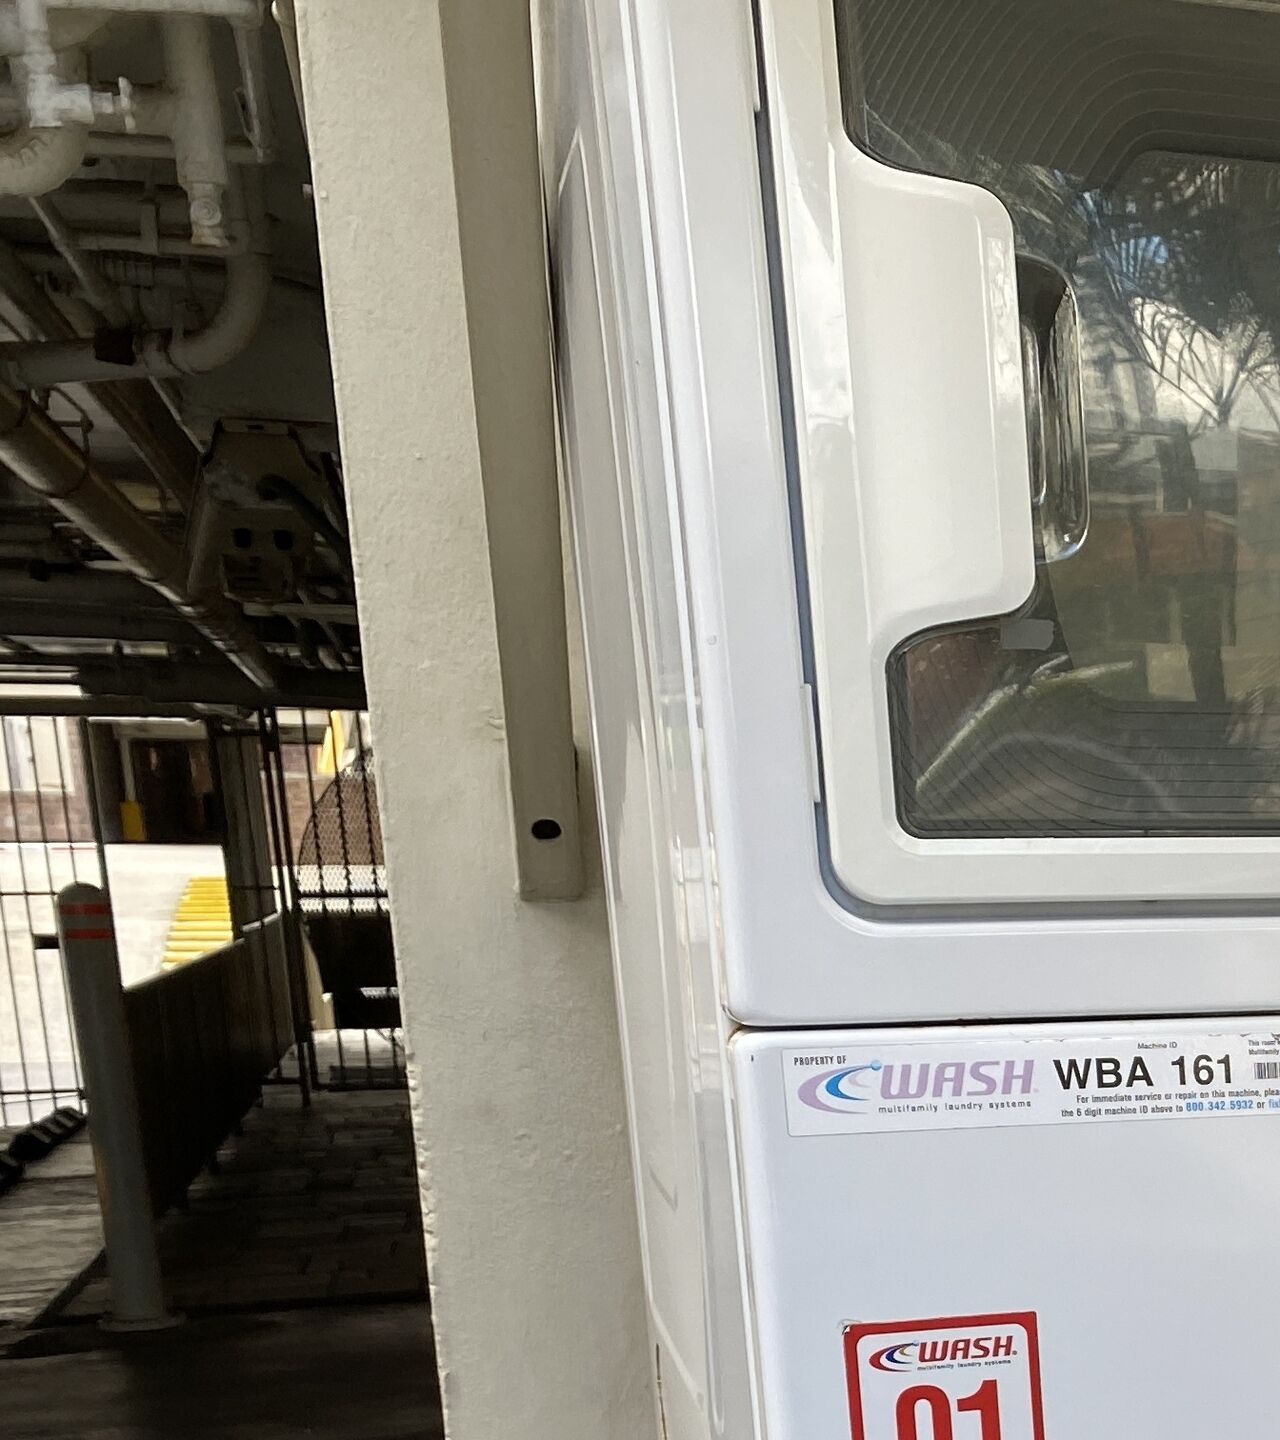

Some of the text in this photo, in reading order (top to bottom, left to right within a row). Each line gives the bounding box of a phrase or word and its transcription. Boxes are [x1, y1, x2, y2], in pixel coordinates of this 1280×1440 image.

[794, 1055, 847, 1067] PROPERTY OF
[880, 1059, 1035, 1100] WASH
[1053, 1054, 1232, 1090] WBA 161
[1076, 1095, 1088, 1103] For
[1092, 1094, 1132, 1103] immediate
[1135, 1092, 1161, 1101] service
[1175, 1091, 1197, 1101] repair
[1212, 1089, 1225, 1098] this
[1228, 1089, 1261, 1098] machine,
[878, 1100, 1031, 1114] multifamily laundry systems
[1085, 1106, 1101, 1117] digit
[1105, 1106, 1136, 1115] machine
[1140, 1106, 1148, 1114] ID
[1151, 1105, 1172, 1113] above
[1175, 1104, 1183, 1112] to
[1186, 1099, 1253, 1112] 800.342.5932
[1257, 1101, 1265, 1109] or
[919, 1336, 1013, 1362] WASH
